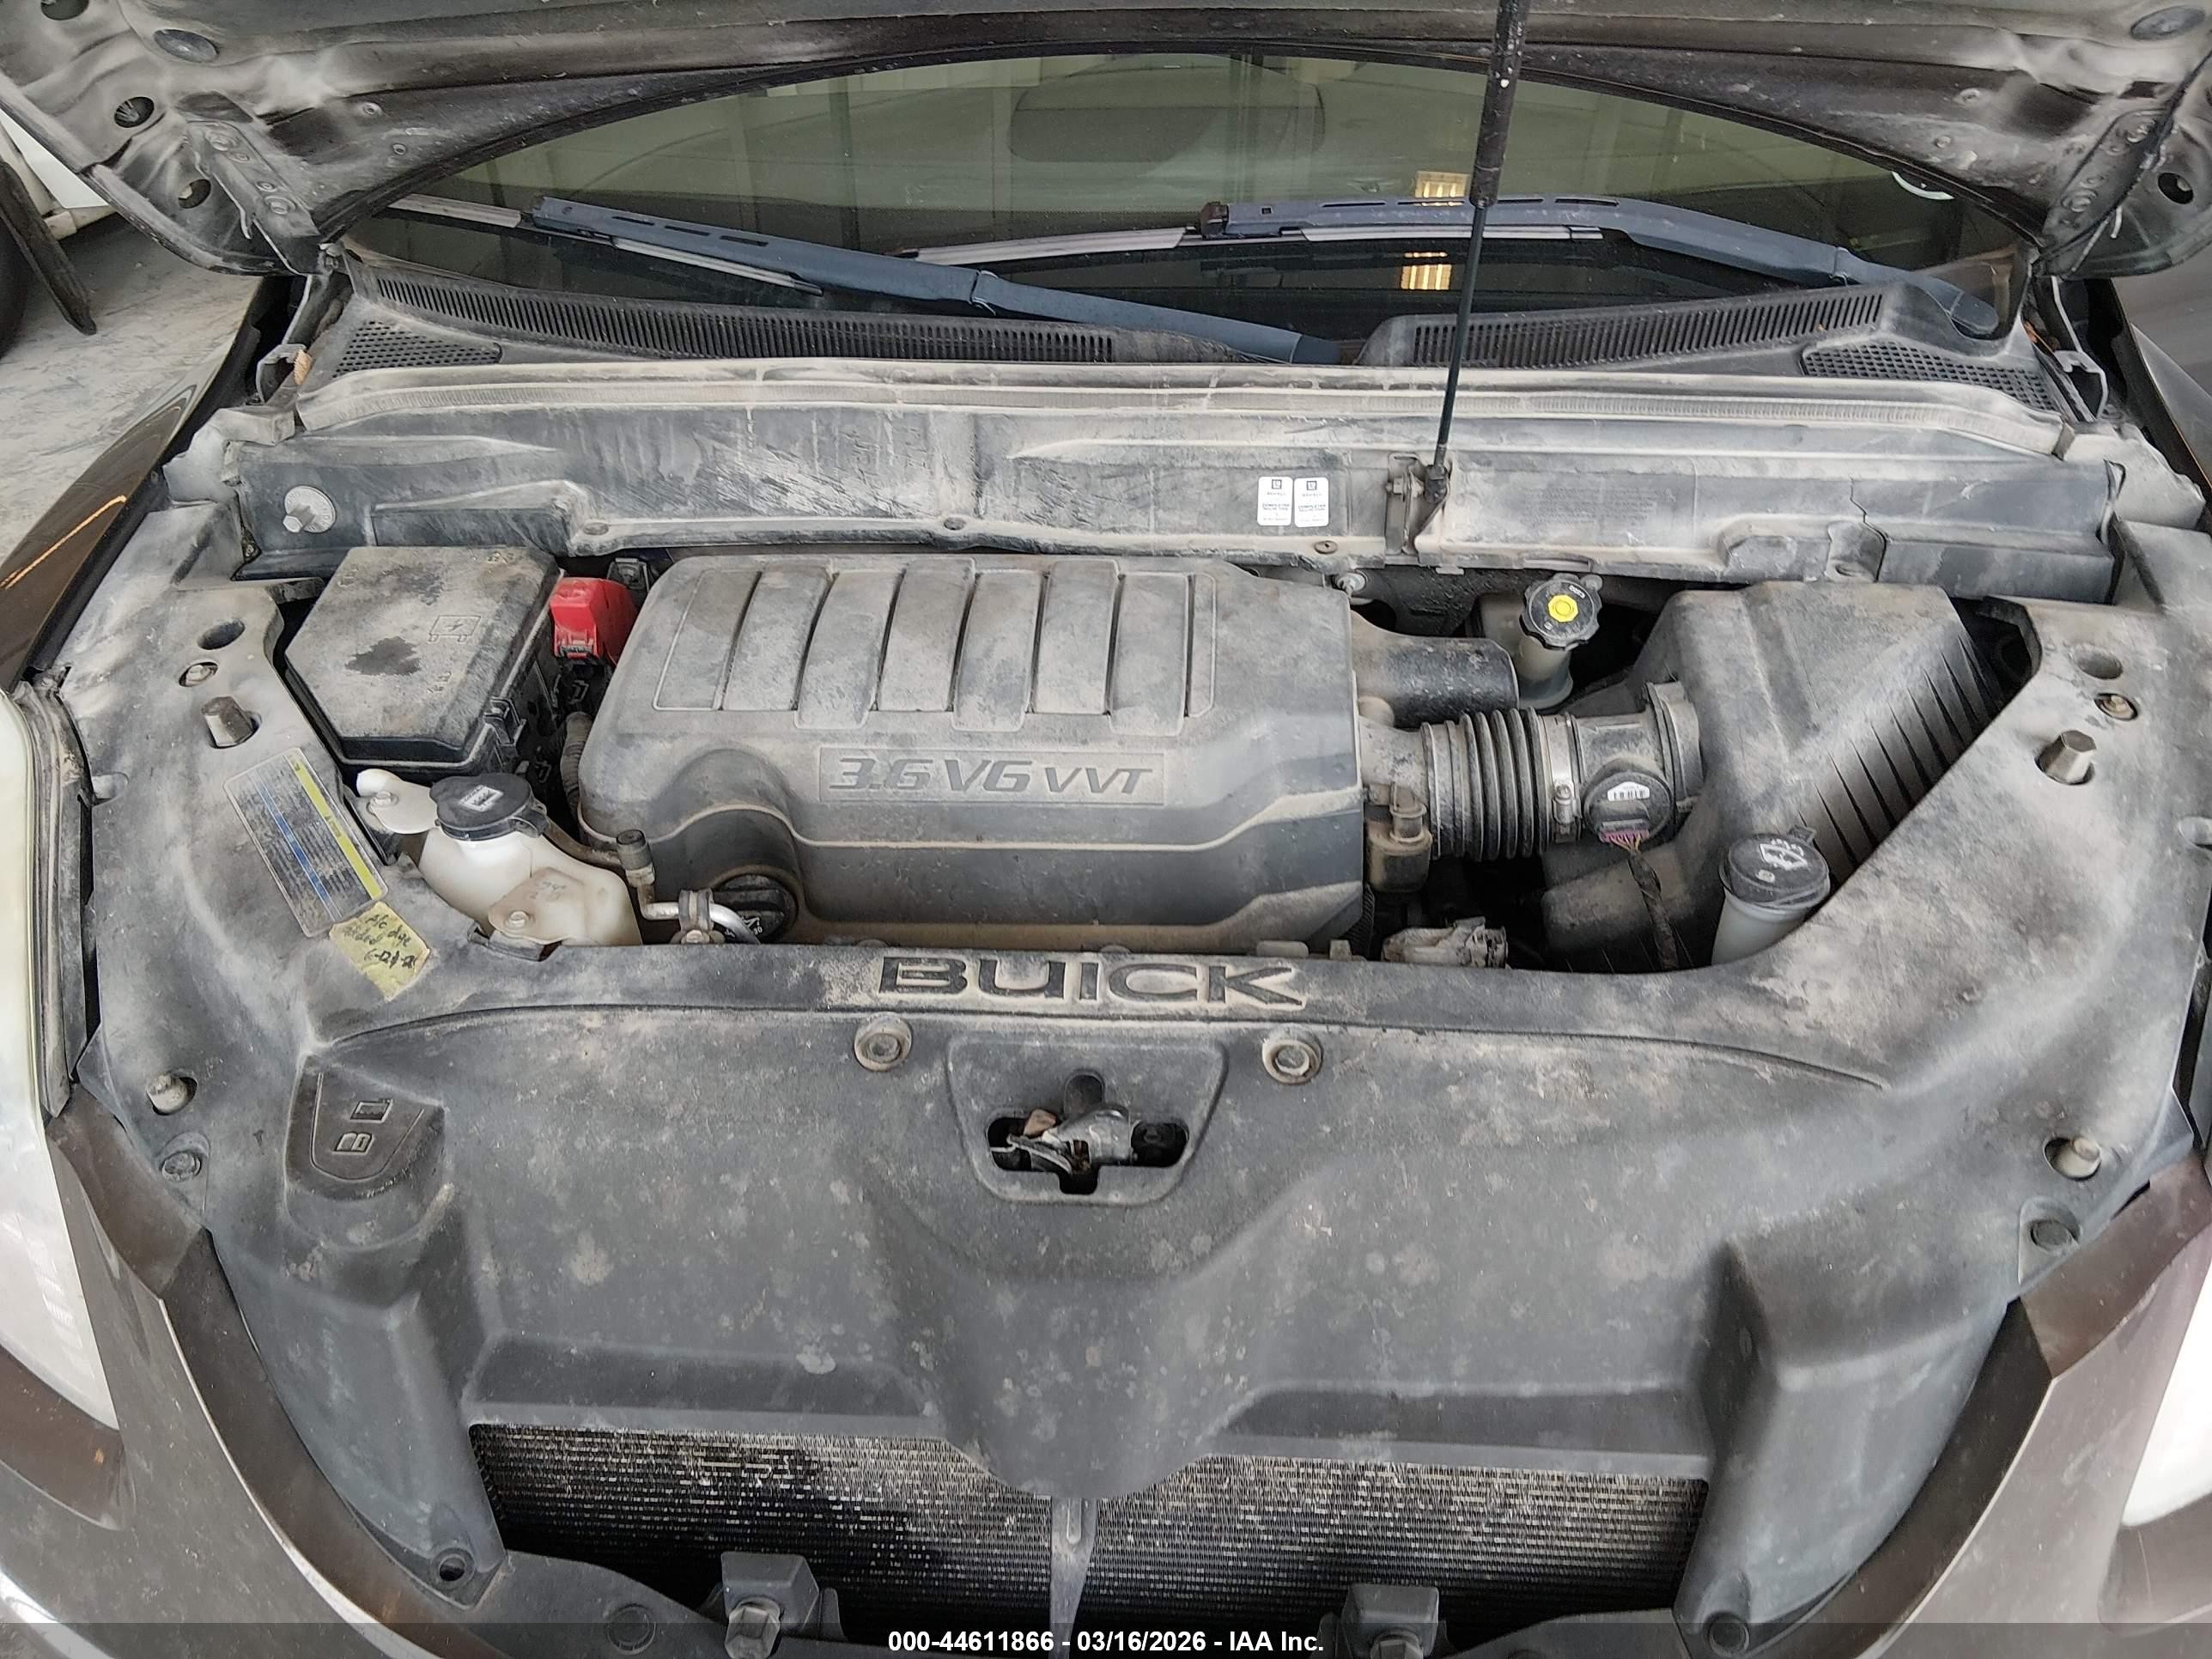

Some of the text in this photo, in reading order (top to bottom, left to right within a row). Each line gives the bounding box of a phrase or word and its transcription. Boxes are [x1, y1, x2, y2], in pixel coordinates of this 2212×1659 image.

[829, 758, 1153, 794] 3.6 V6 VVT
[879, 956, 1303, 1008] BUICK
